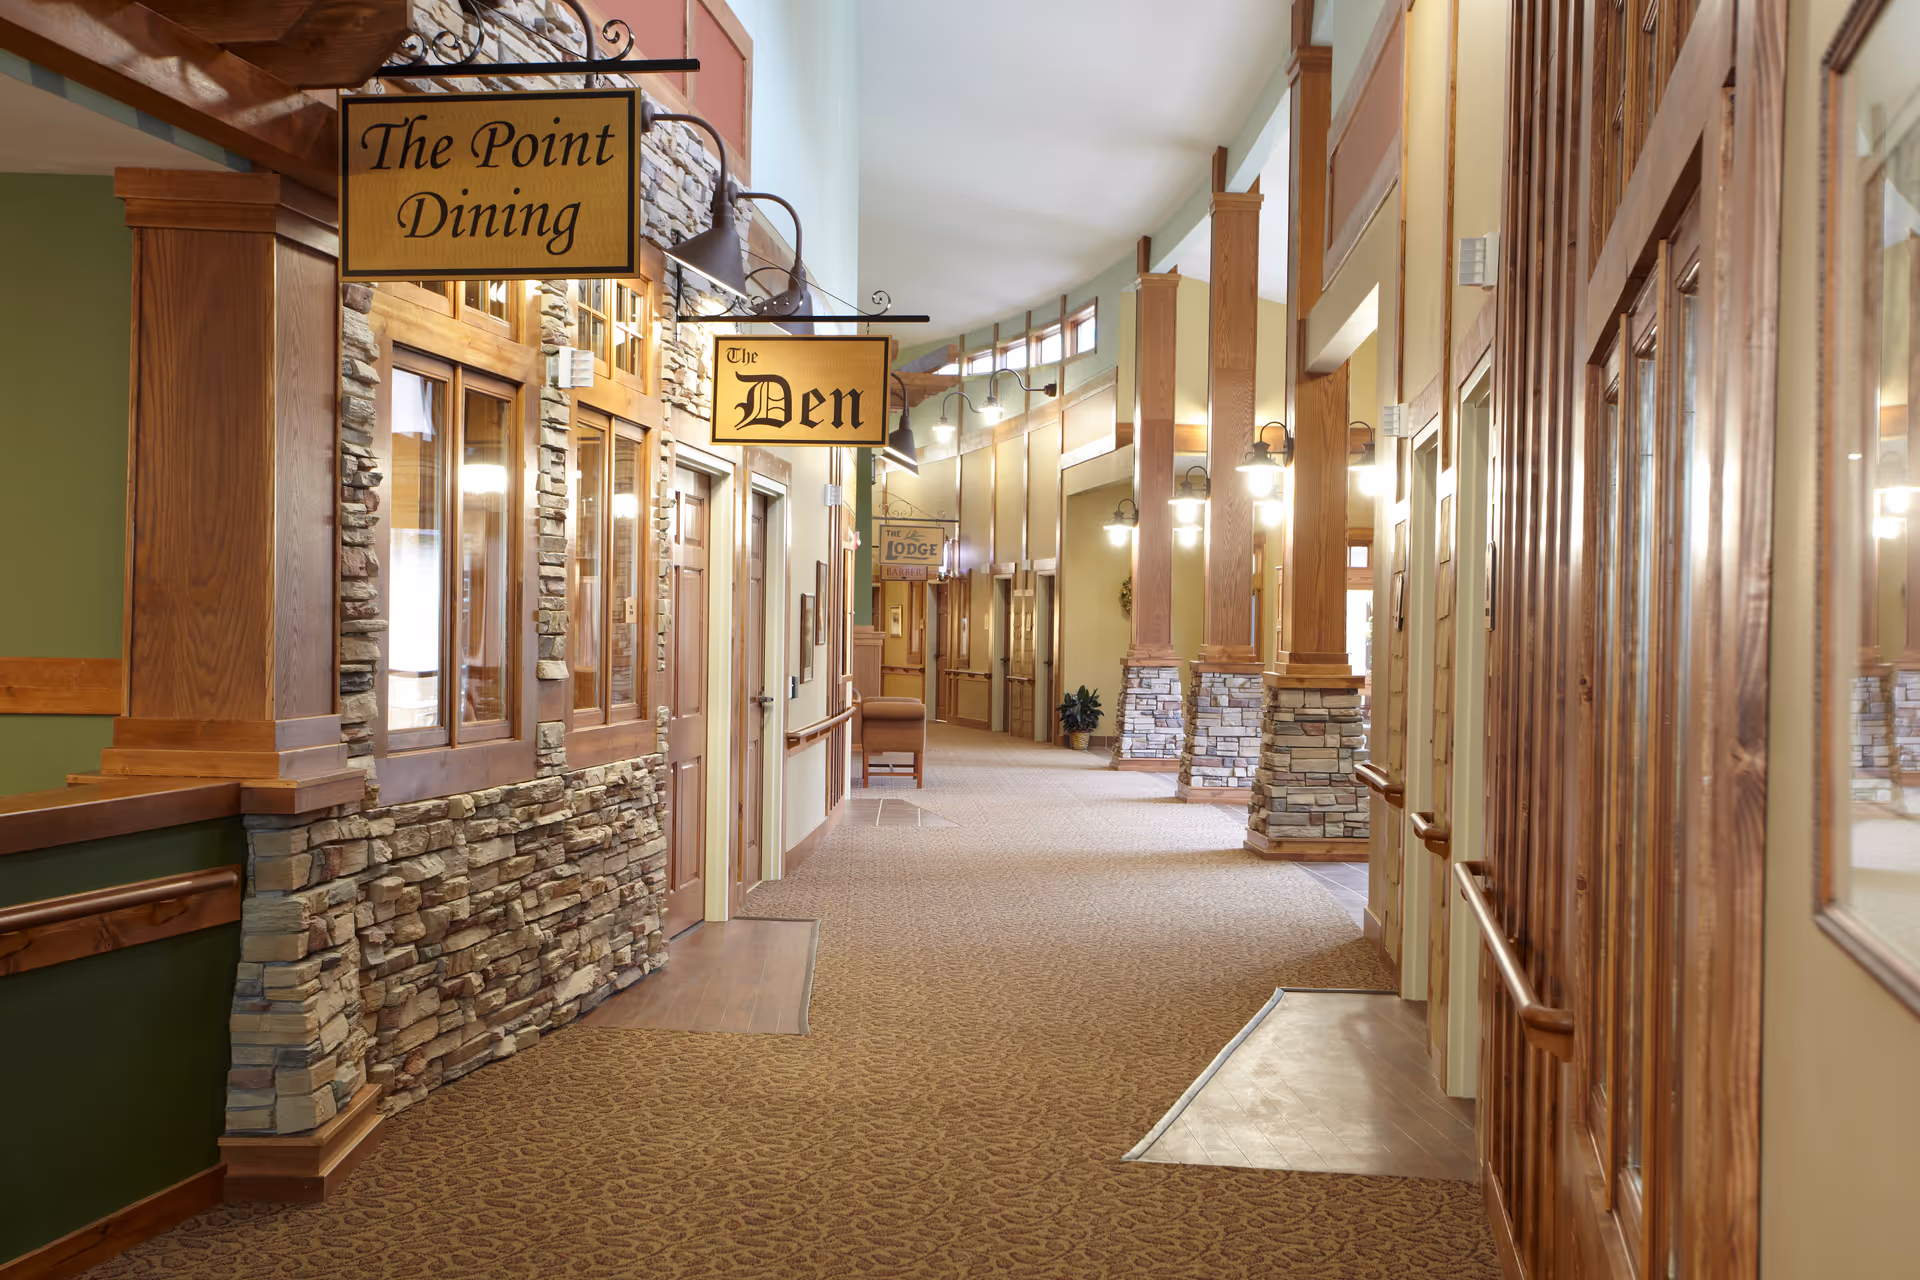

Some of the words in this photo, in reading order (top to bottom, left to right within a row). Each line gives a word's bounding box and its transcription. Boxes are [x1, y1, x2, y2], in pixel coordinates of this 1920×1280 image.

[361, 114, 453, 170] The
[471, 117, 615, 168] Point
[397, 187, 582, 256] Dining
[726, 347, 758, 366] The
[734, 371, 864, 431] Den
[886, 529, 902, 538] THE
[885, 540, 938, 560] LODGE
[886, 567, 922, 577] BARBER
